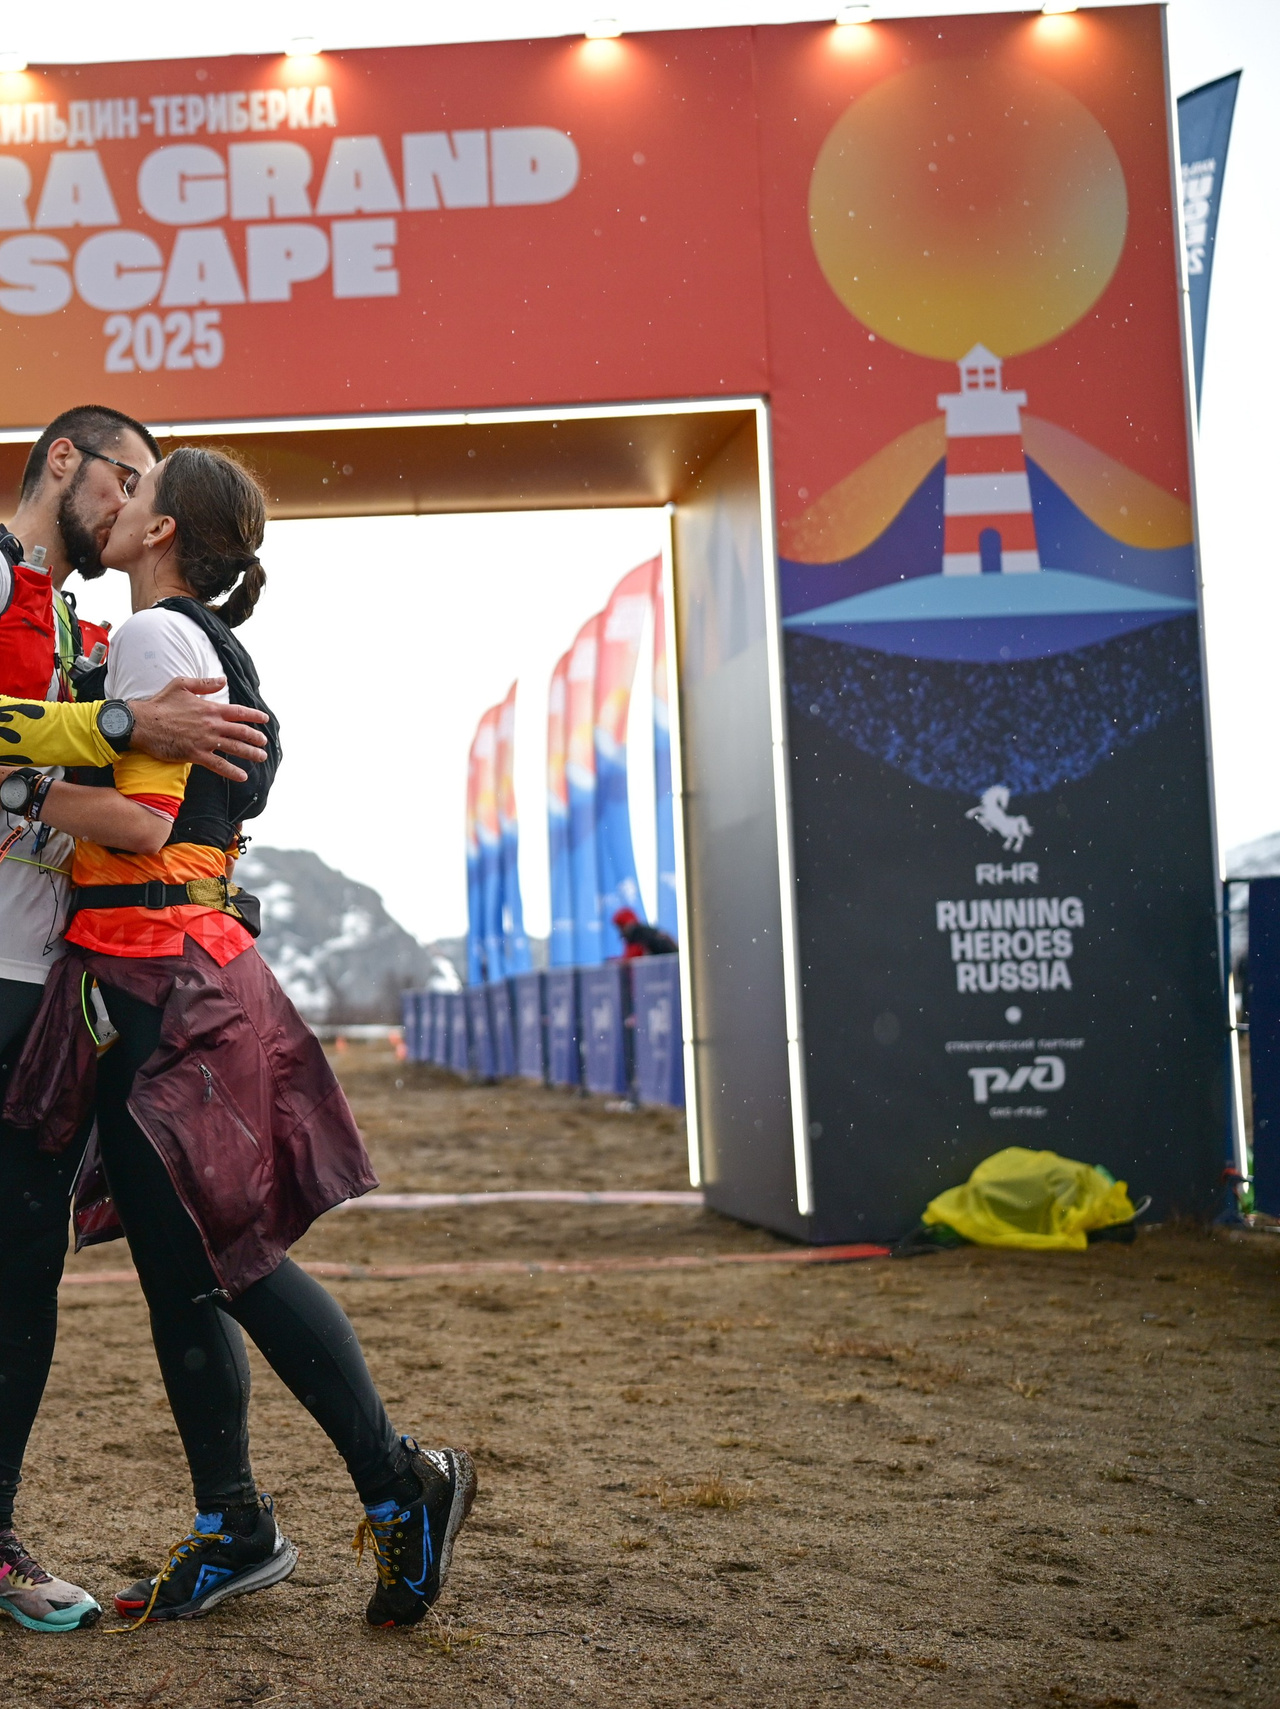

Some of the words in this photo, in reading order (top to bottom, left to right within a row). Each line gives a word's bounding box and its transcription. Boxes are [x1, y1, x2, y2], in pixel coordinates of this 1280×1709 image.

[138, 126, 581, 226] GRAND
[103, 310, 224, 373] 2025
[975, 861, 1040, 886] RHR
[935, 895, 1085, 933] RUNNING
[950, 928, 1074, 962] HEROES
[955, 959, 1073, 994] RUSSIA
